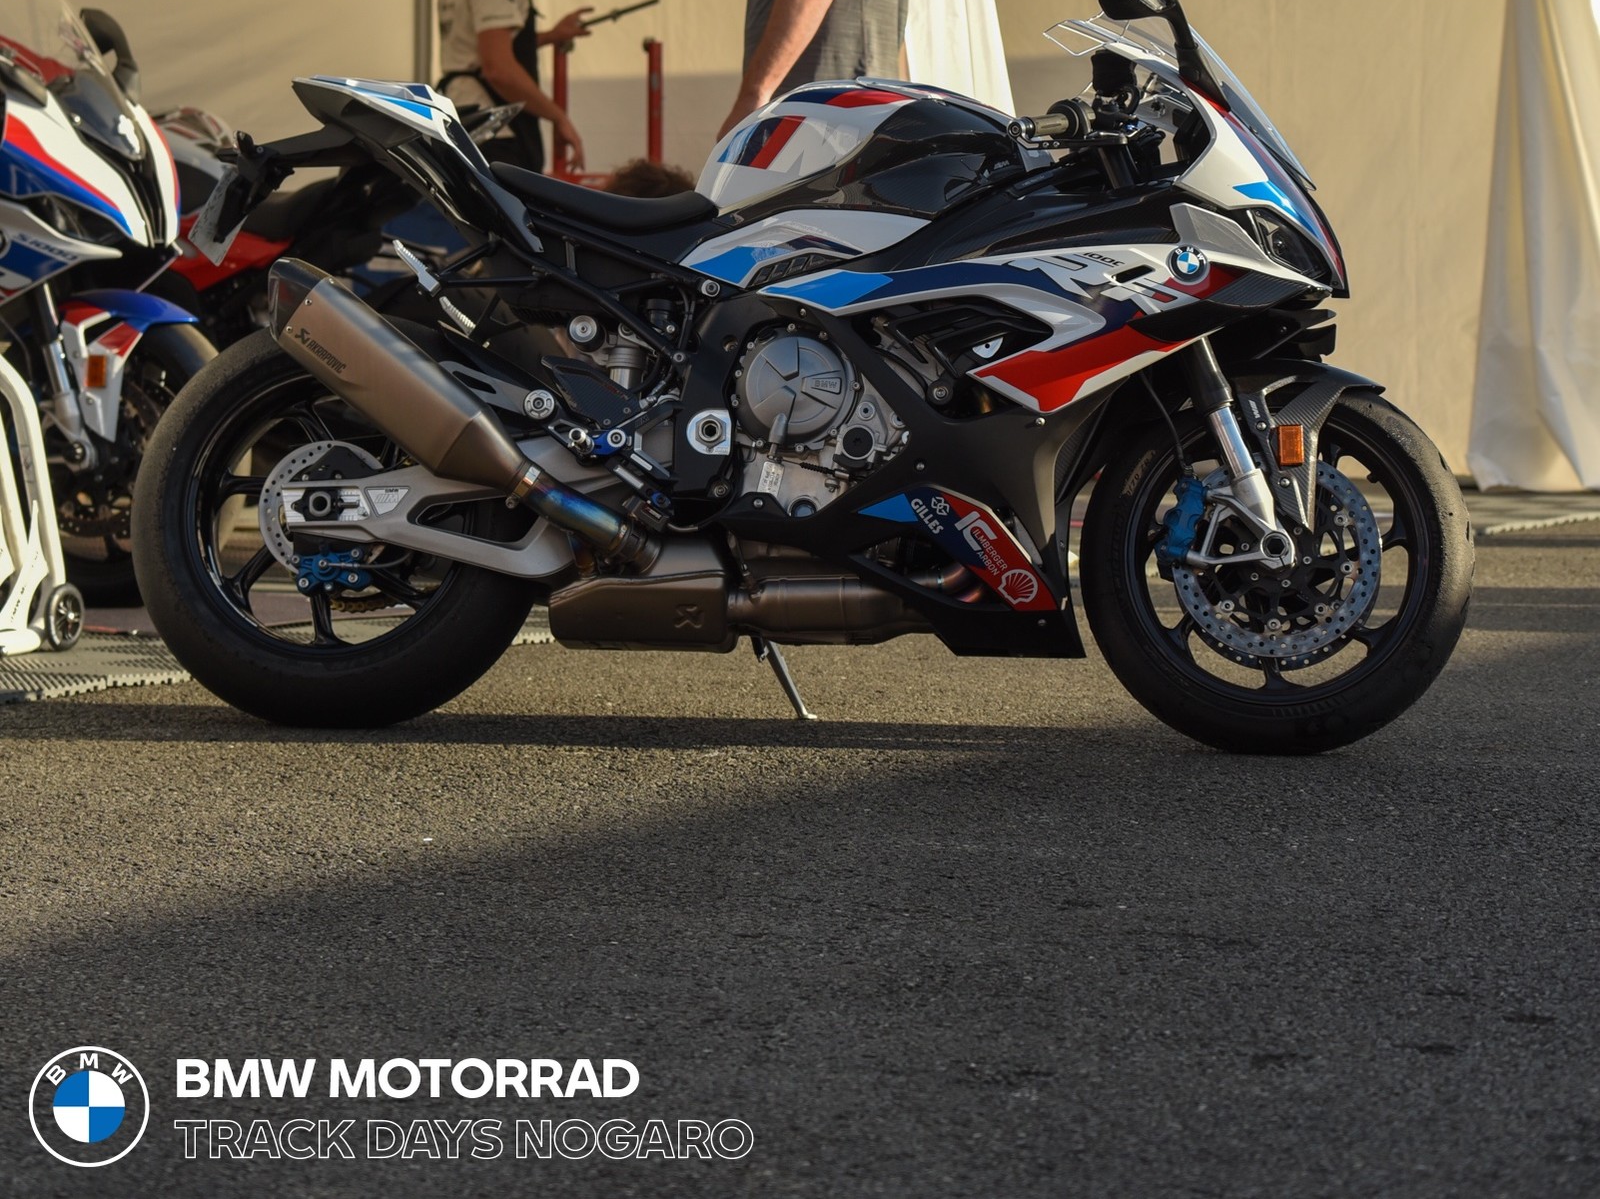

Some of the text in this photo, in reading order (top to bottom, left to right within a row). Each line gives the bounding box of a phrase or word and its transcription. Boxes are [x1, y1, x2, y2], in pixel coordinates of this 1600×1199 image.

[1174, 247, 1205, 261] BMW
[814, 380, 838, 389] BMW
[911, 499, 945, 534] GILLES
[972, 529, 1008, 571] ILMBERGER
